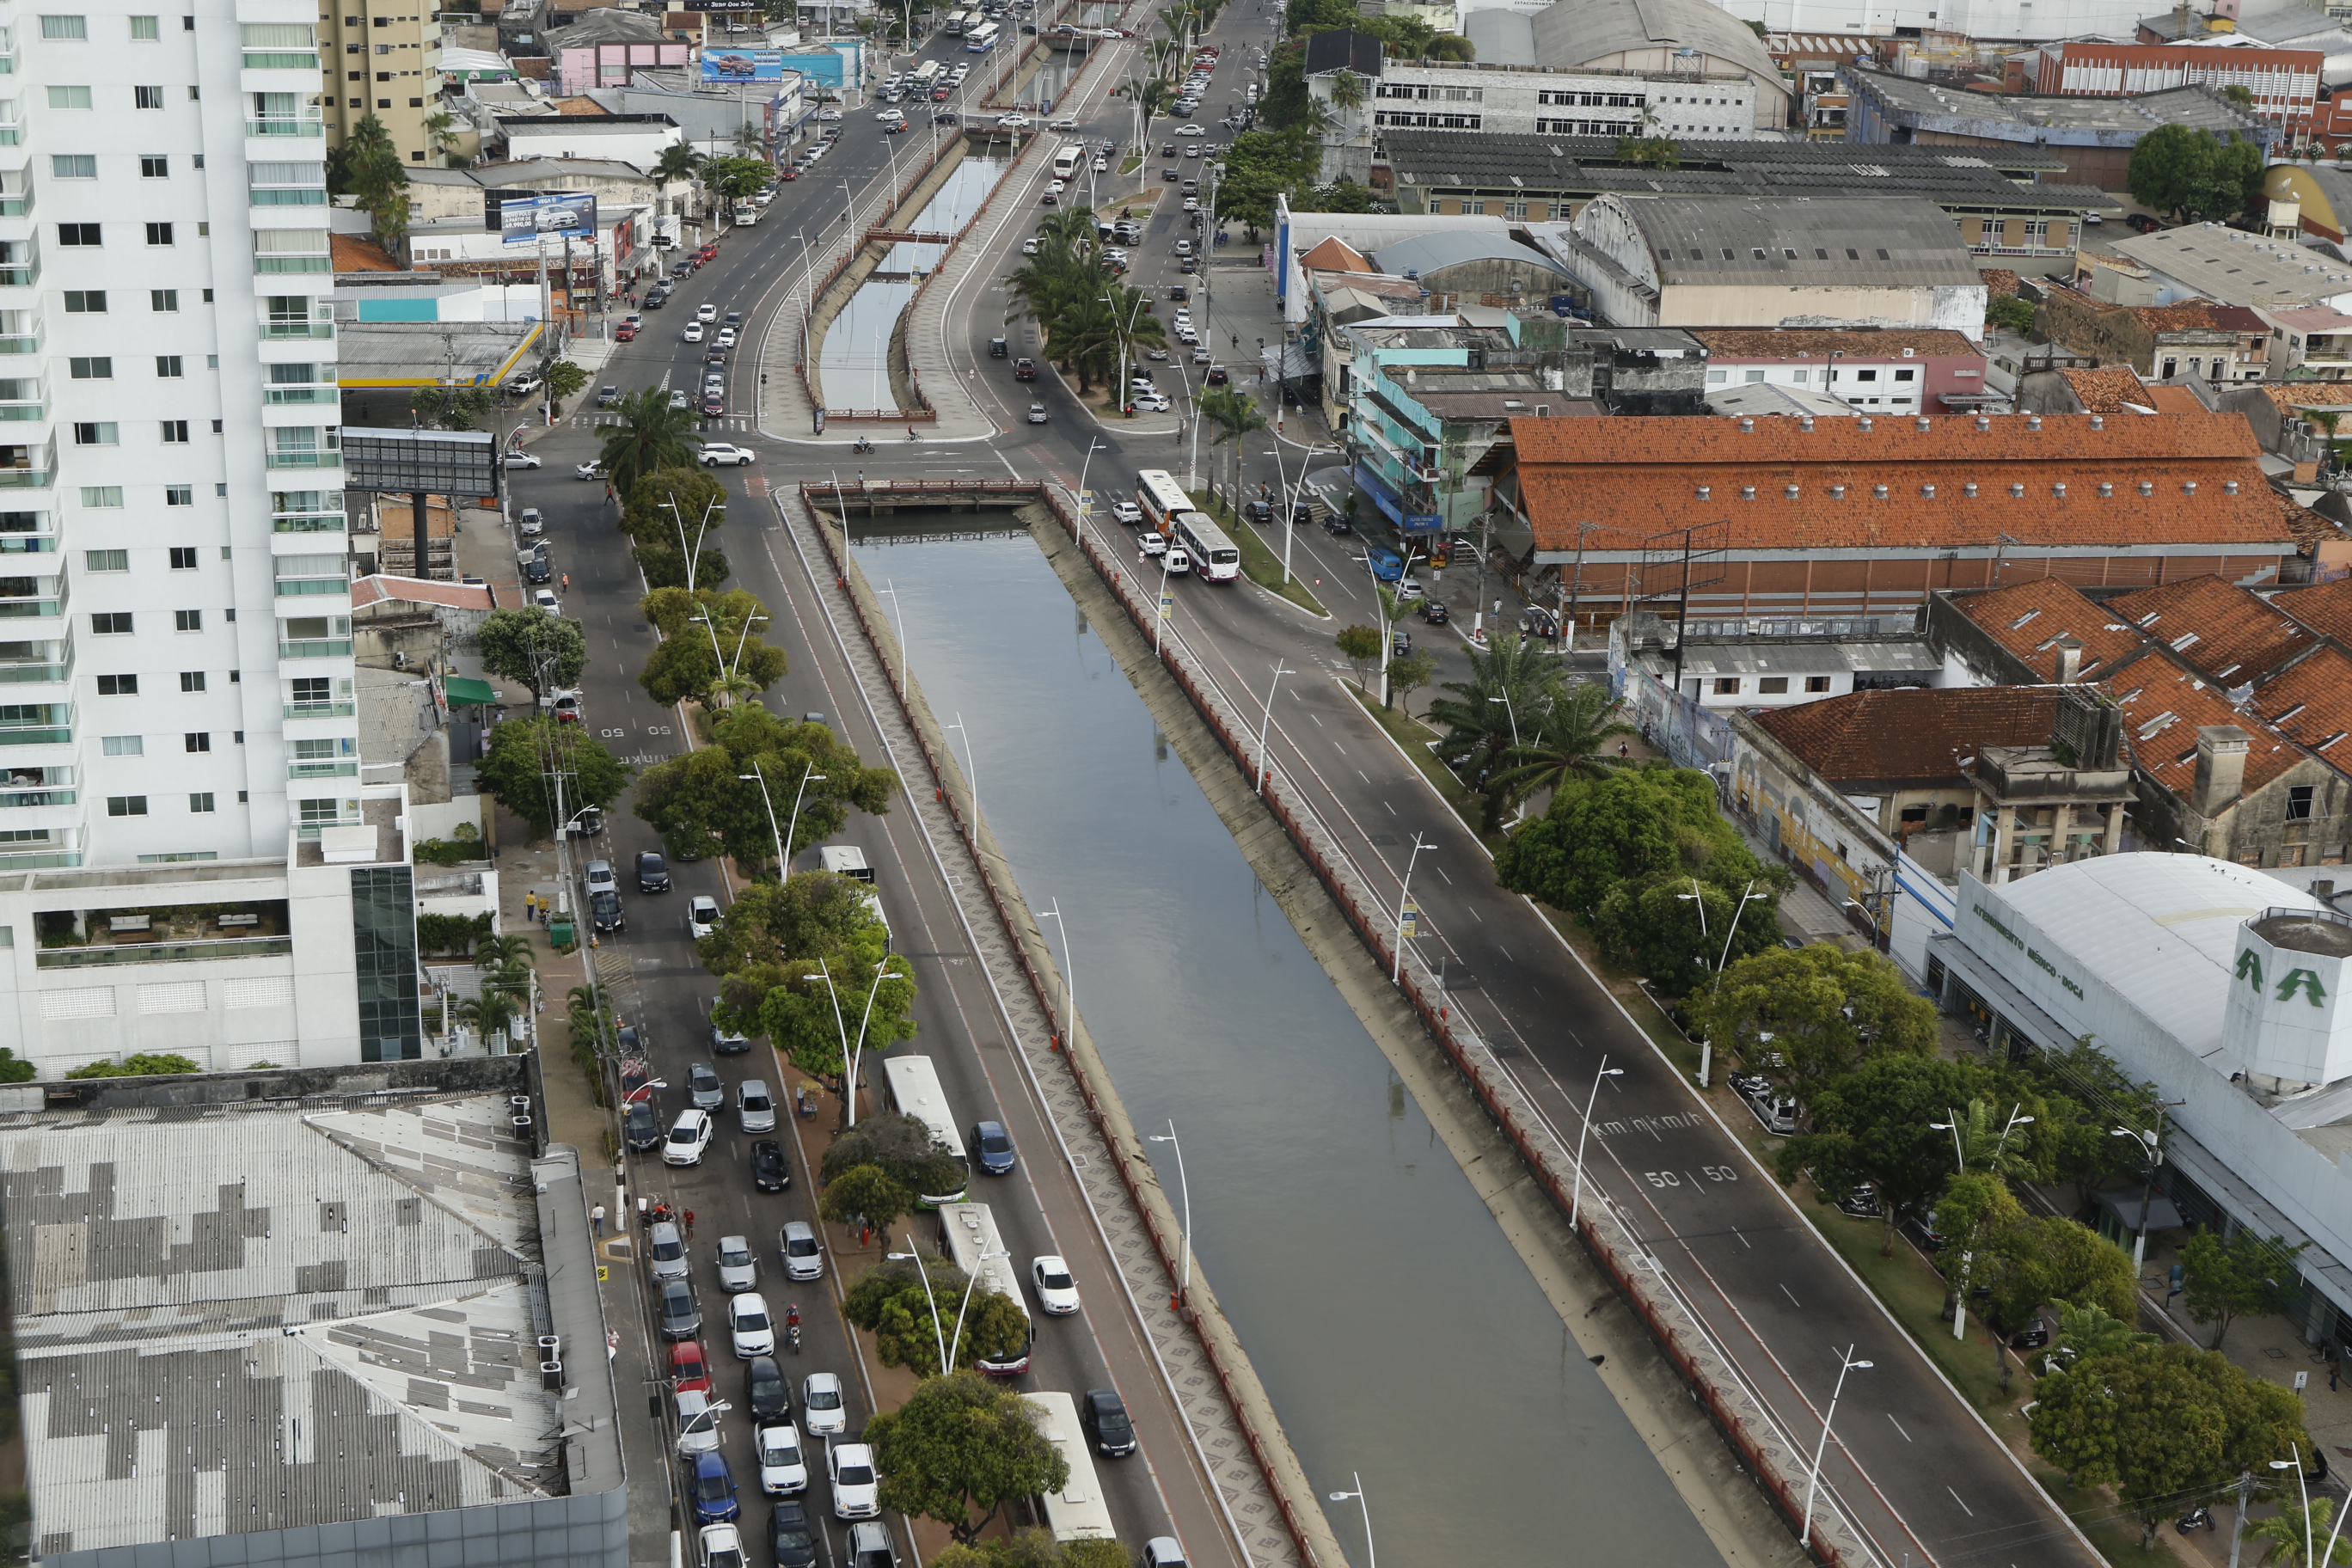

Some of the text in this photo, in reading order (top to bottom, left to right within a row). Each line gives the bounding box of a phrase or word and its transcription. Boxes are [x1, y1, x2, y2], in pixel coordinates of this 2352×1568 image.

[601, 726, 671, 738] 50 50
[1973, 903, 2024, 951] ATENDIMENTO
[2027, 946, 2056, 977] MÉDICO
[2061, 974, 2084, 1001] DOCA
[1645, 1166, 1738, 1188] 50 50
